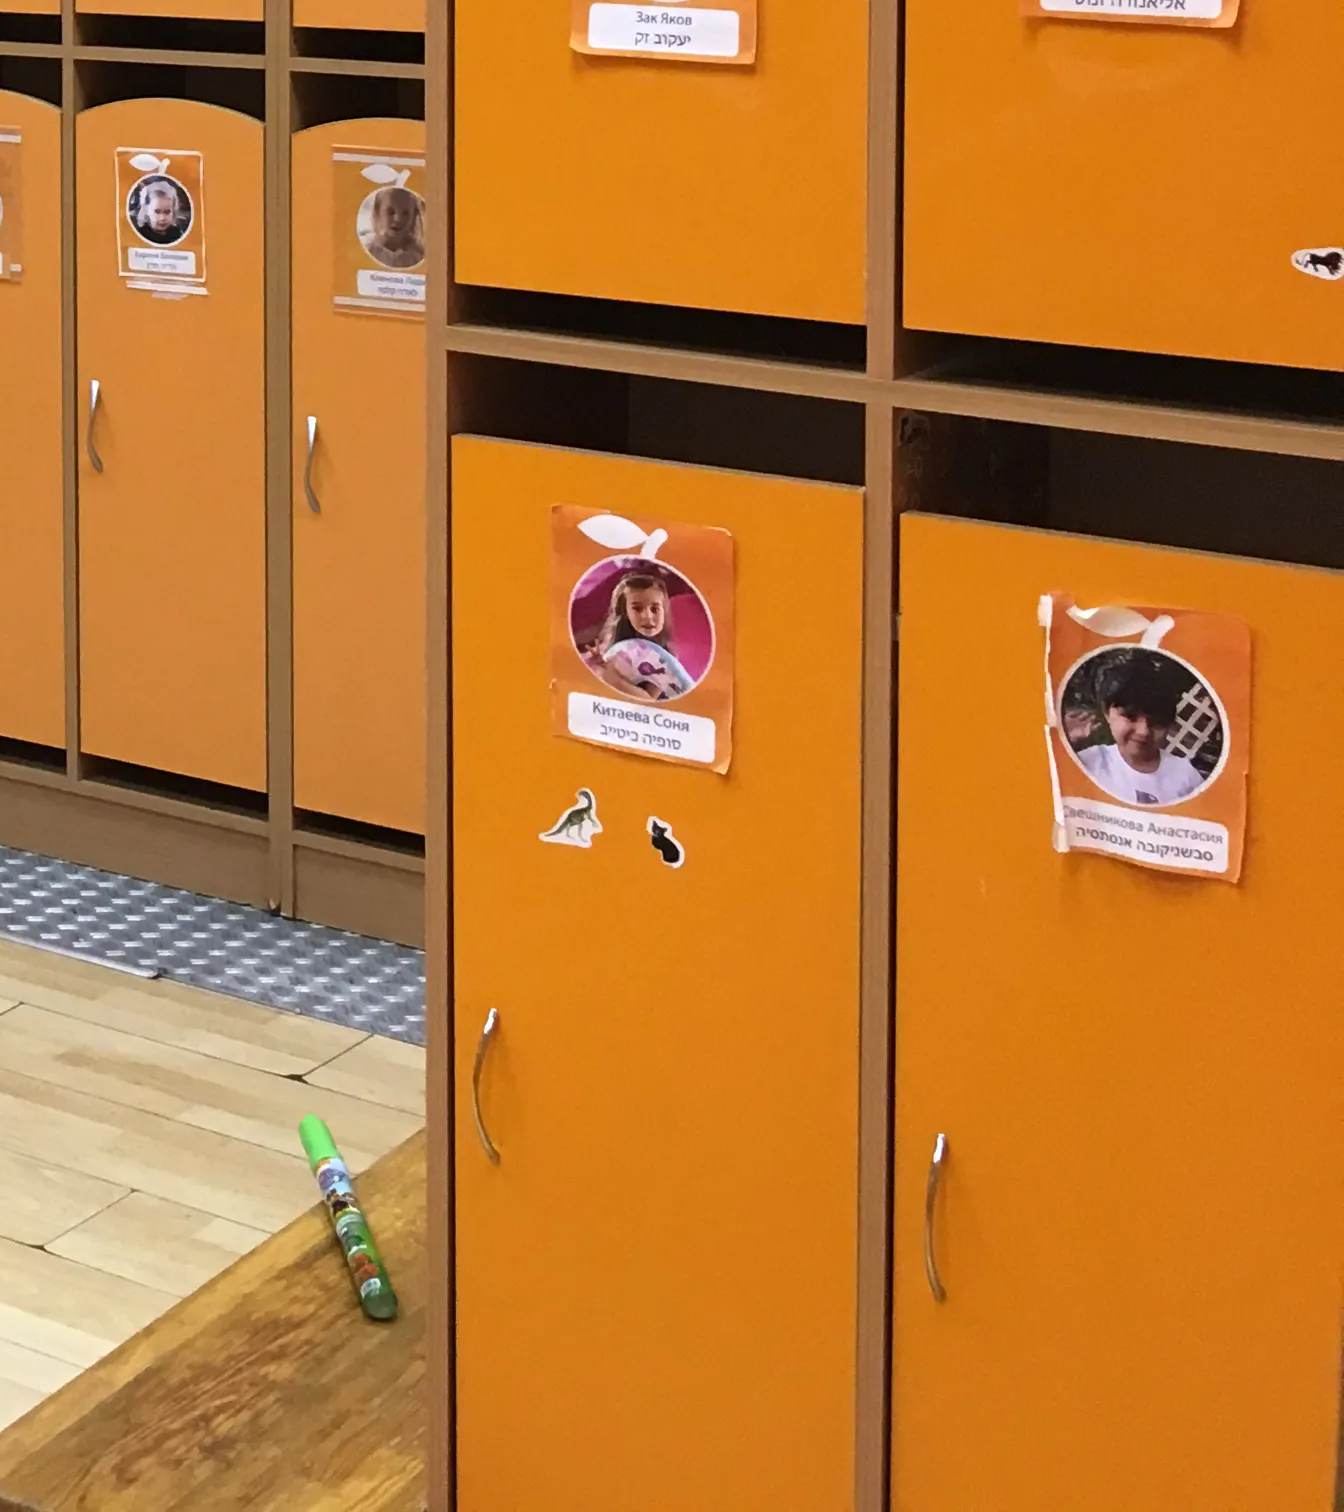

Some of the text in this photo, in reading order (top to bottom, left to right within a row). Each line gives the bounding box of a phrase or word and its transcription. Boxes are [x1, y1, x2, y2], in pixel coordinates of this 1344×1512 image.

[636, 10, 692, 26] Зак Яков
[634, 32, 692, 47] יעקוב זק
[592, 701, 690, 732] Китаева Соня
[642, 733, 681, 750] סופיה
[1147, 822, 1223, 844] Анастасия
[1136, 840, 1214, 861] סבשניקובה
